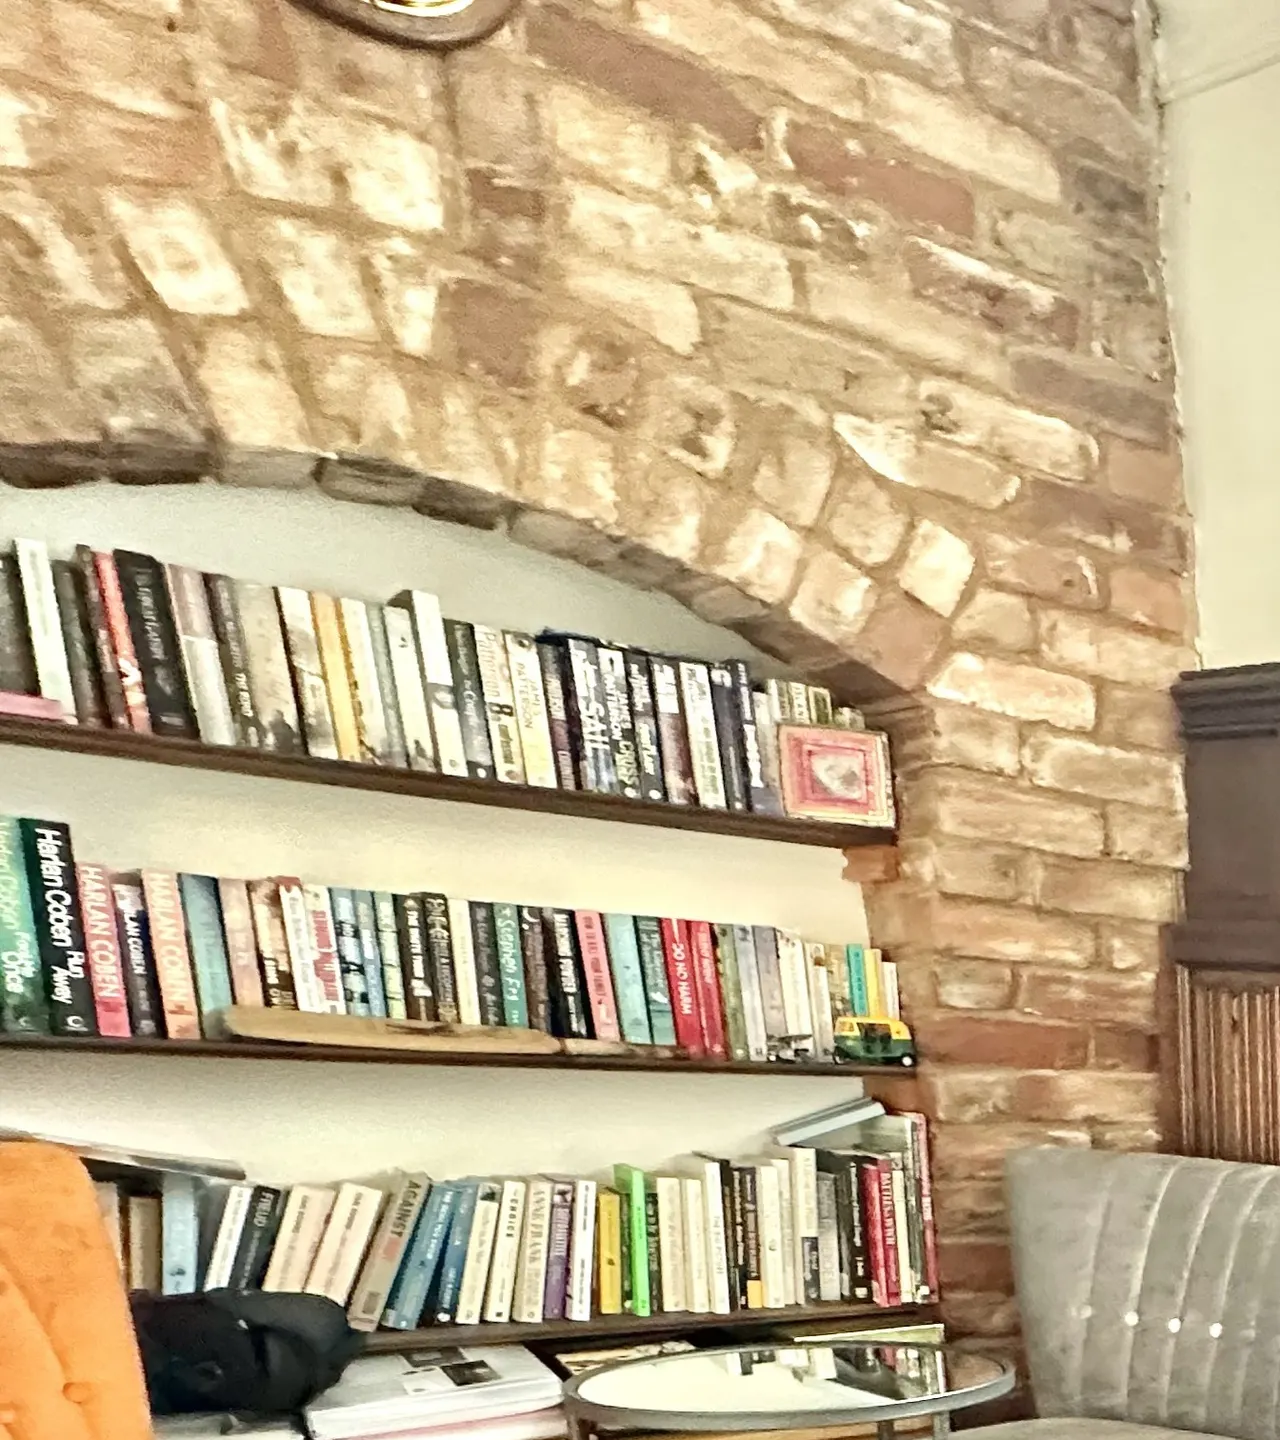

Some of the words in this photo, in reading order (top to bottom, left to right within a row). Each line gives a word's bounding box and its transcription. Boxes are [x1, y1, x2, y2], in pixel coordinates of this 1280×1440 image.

[477, 630, 503, 698] Patterson
[515, 662, 534, 729] PATTERSON
[603, 673, 623, 741] PATTERSON
[616, 692, 632, 730] JAMES
[578, 695, 611, 757] SAIL
[35, 825, 68, 889] Harlan
[44, 888, 78, 949] Coben
[81, 864, 110, 937] HARLAN
[148, 870, 179, 942] HARLAN
[127, 937, 146, 975] COBEN
[496, 917, 519, 973] Stephen
[554, 913, 572, 957] MARCHING
[672, 943, 685, 960] DO
[2, 950, 26, 994] Once
[47, 964, 74, 1007] Away
[67, 949, 87, 980] Run
[91, 938, 121, 1000] COBEN
[161, 943, 189, 1003] COBEN
[559, 958, 577, 994] POWDER
[675, 962, 688, 980] NO
[504, 976, 521, 1002] Fry
[679, 981, 692, 1015] HARM
[253, 1192, 273, 1227] FREUD
[390, 1179, 422, 1238] AGAINST
[505, 1197, 520, 1239] CHOICE
[531, 1189, 545, 1221] ANNE
[528, 1223, 545, 1265] FRANK
